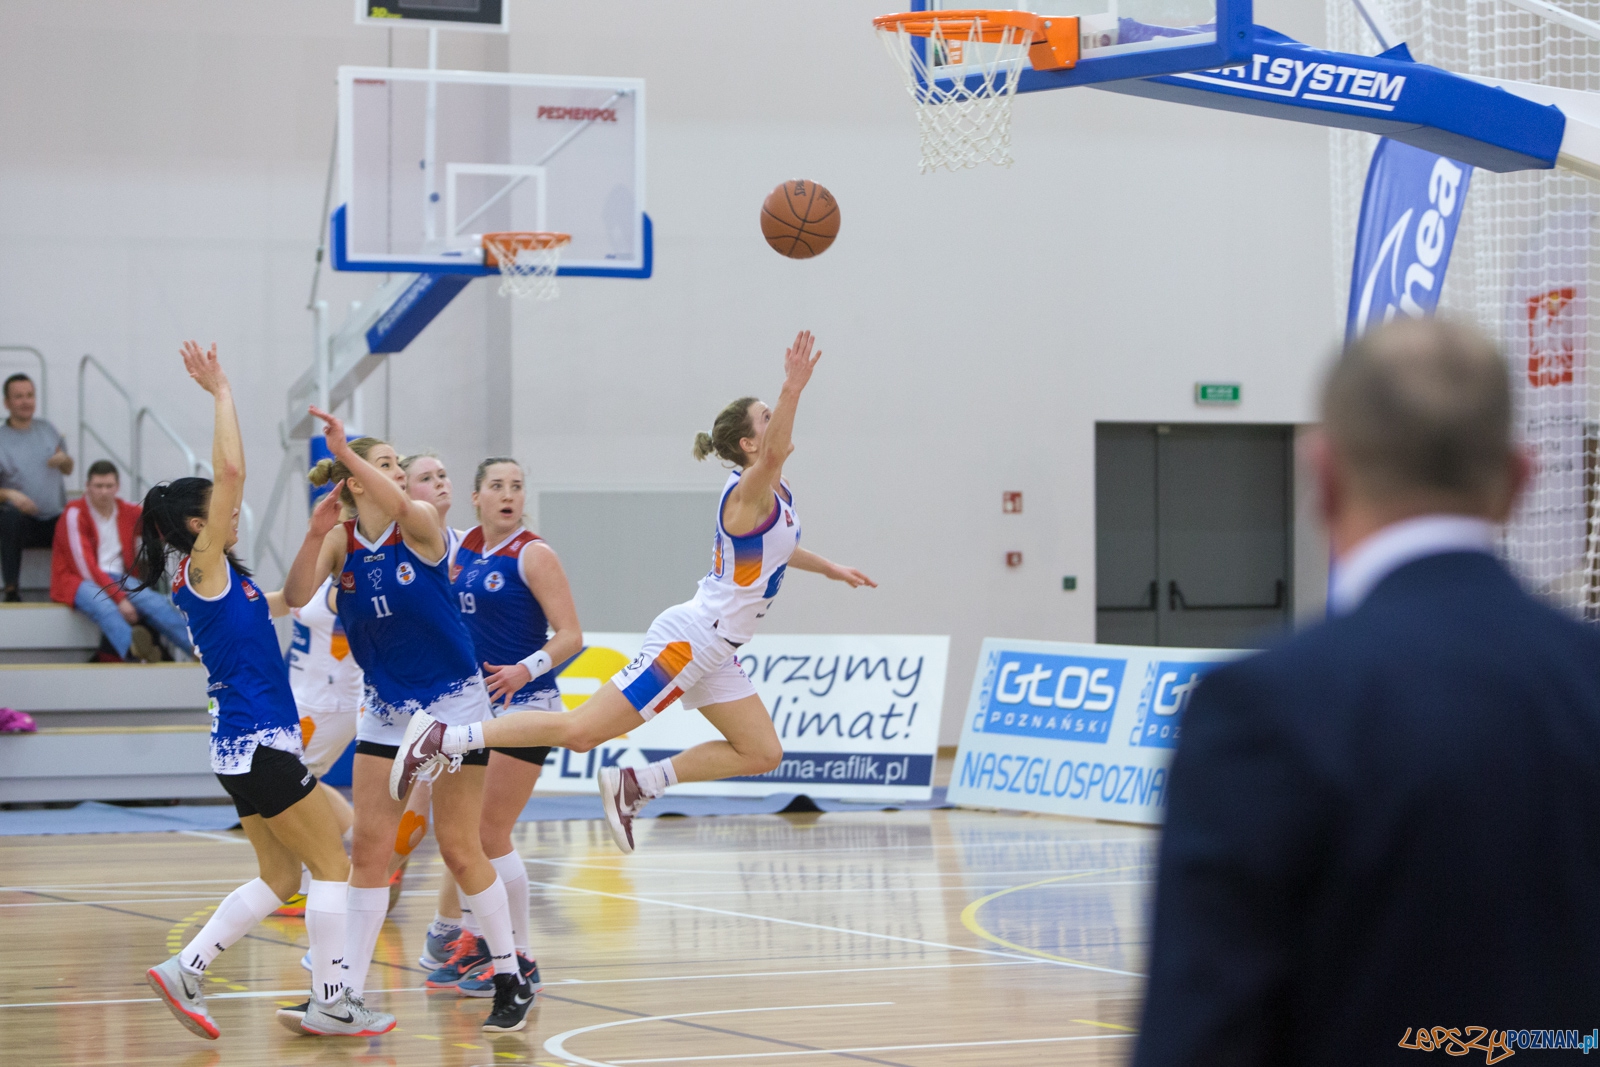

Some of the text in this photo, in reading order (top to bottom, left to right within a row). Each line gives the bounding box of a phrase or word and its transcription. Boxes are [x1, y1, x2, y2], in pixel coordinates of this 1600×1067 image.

[1384, 157, 1462, 322] nea
[371, 595, 393, 618] 11
[458, 592, 476, 614] 19
[739, 654, 924, 697] orzymy
[771, 695, 918, 740] limat!
[990, 711, 1108, 734] POZNAŃSKI
[959, 751, 1168, 807] NASZGLOSPOZNA
